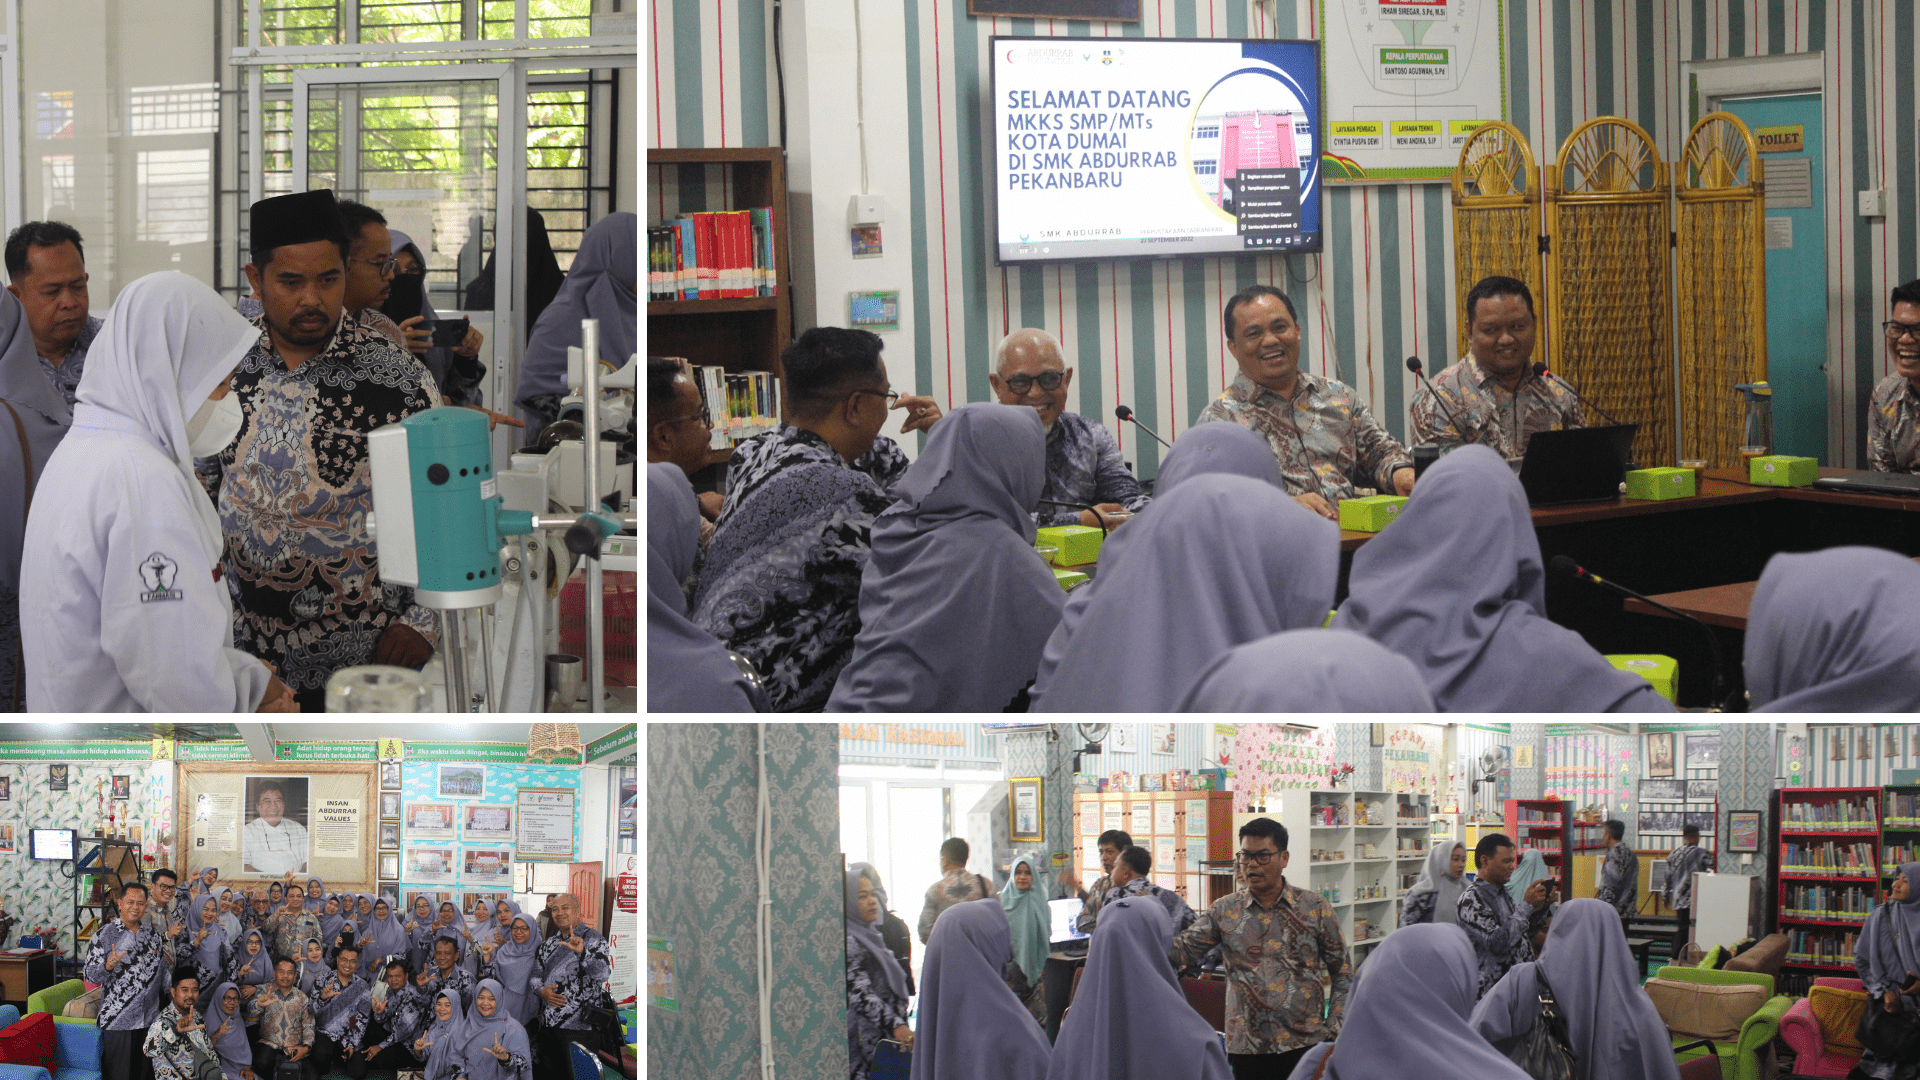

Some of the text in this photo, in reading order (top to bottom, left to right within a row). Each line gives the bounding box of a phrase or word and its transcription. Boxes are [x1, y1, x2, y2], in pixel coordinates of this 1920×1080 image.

[1385, 52, 1444, 61] KEPALA PERPUSTAKAAN
[1384, 67, 1408, 75] SANTOSO
[1008, 89, 1191, 109] SELAMAT DATANG
[1008, 112, 1153, 132] MKKS SMP/MTs
[1008, 132, 1127, 150] KOTA DUMAI
[1352, 137, 1367, 145] PUSPA
[1758, 132, 1800, 146] TOILET
[1009, 151, 1177, 170] DI SMK ABDURRAB
[1009, 172, 1123, 190] PEKANBARU
[1040, 228, 1122, 238] SMK ABDURRAB
[10, 747, 46, 756] membuang
[90, 747, 109, 756] hidup
[313, 745, 332, 753] hidup
[593, 740, 617, 756] Sebelum
[1260, 759, 1331, 777] PEKANBARU
